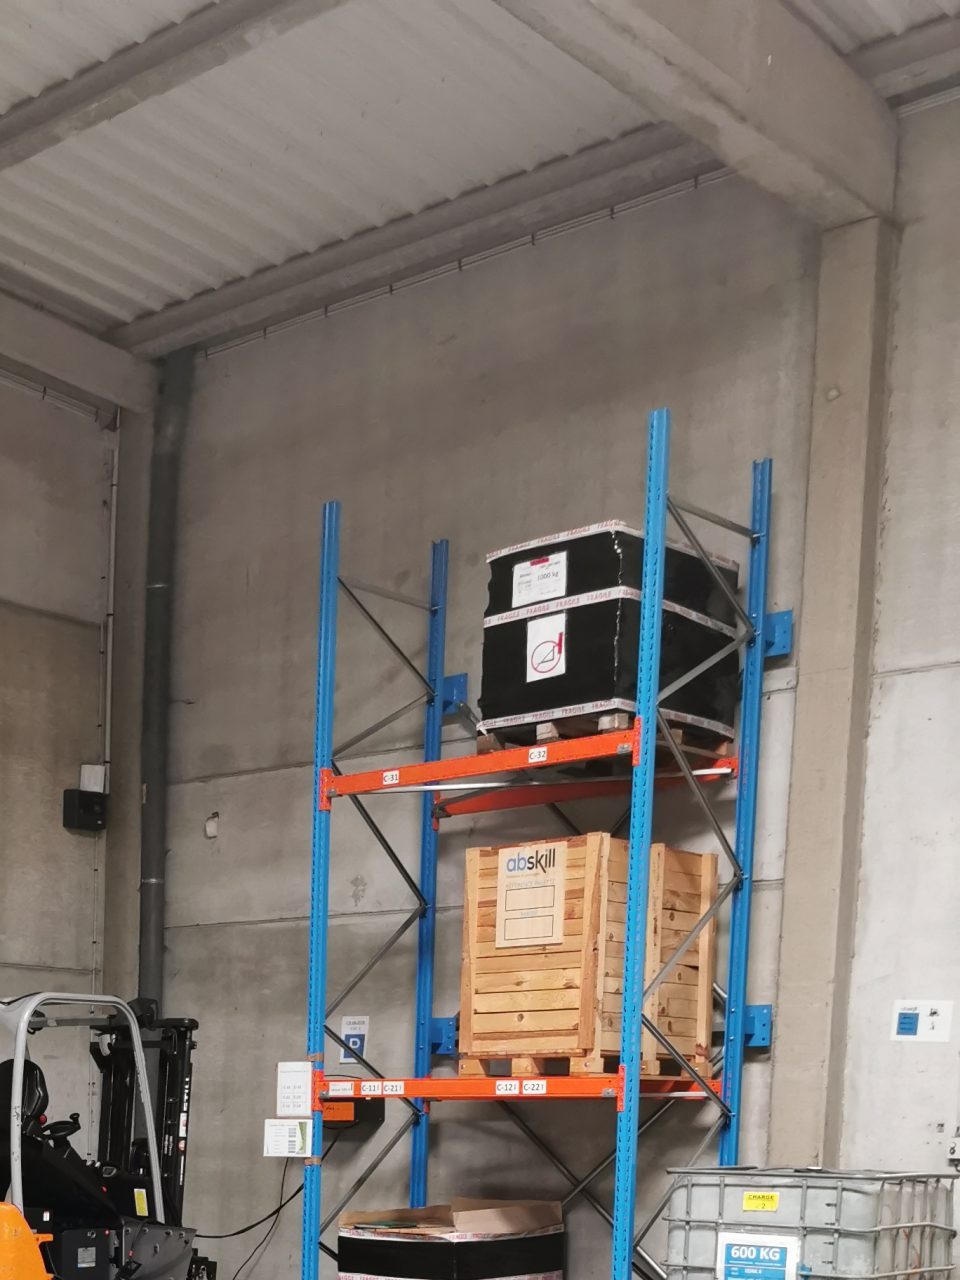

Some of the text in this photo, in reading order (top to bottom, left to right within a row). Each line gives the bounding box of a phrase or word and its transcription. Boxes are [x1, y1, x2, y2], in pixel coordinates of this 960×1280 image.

[529, 750, 546, 760] C-32
[383, 773, 398, 783] C-31
[507, 848, 555, 874] abskill
[361, 1084, 376, 1092] C-11
[383, 1084, 398, 1092] C-21
[496, 1083, 513, 1091] C-12
[523, 1083, 540, 1091] C-22
[731, 1245, 780, 1260] 600 KG
